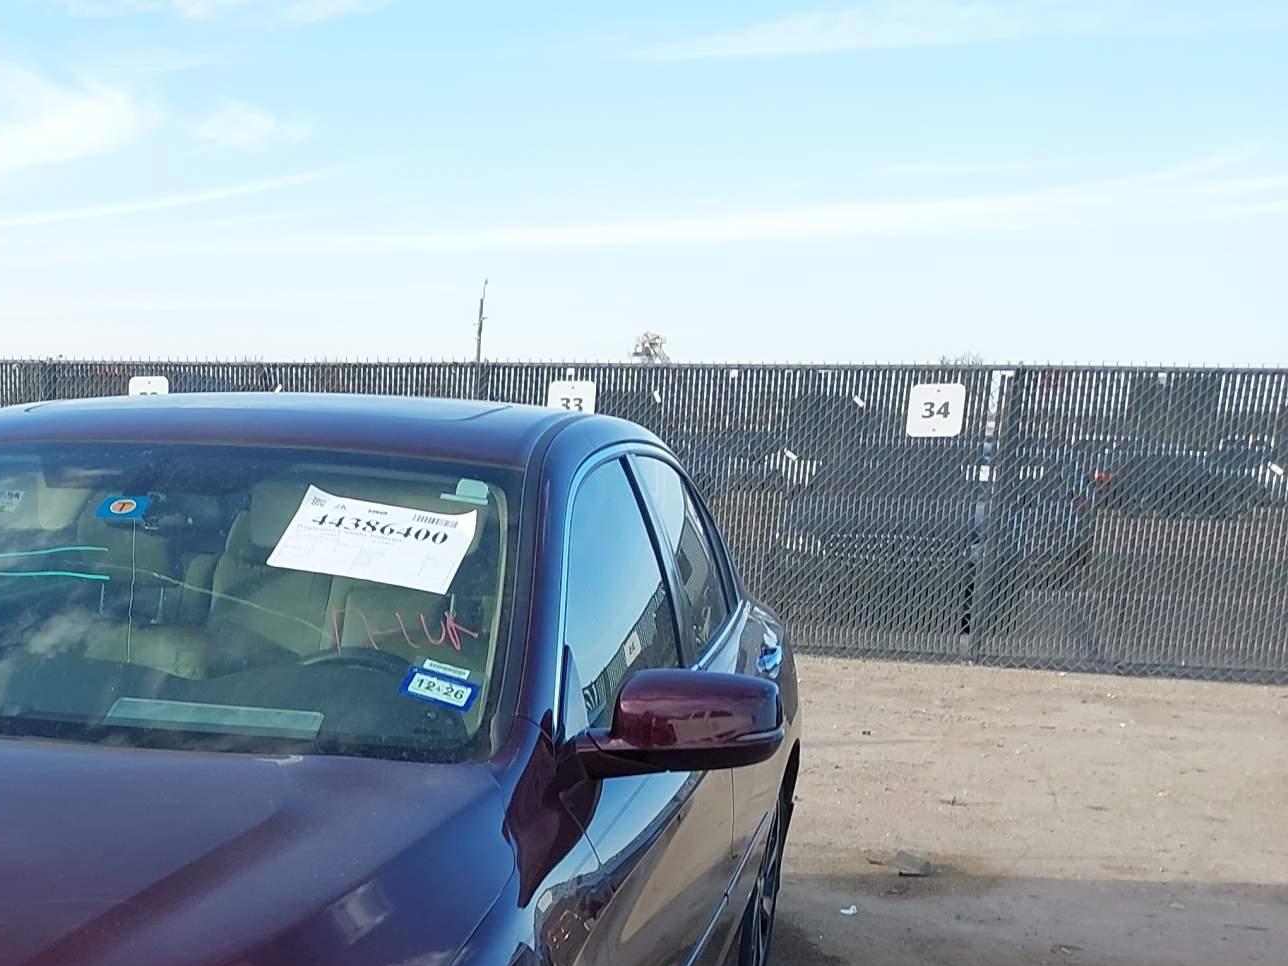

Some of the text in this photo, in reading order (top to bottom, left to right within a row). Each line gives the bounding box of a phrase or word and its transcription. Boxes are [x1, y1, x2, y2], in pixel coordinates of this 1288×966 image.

[560, 397, 583, 411] 33
[921, 401, 950, 419] 34
[311, 513, 449, 545] 44386400
